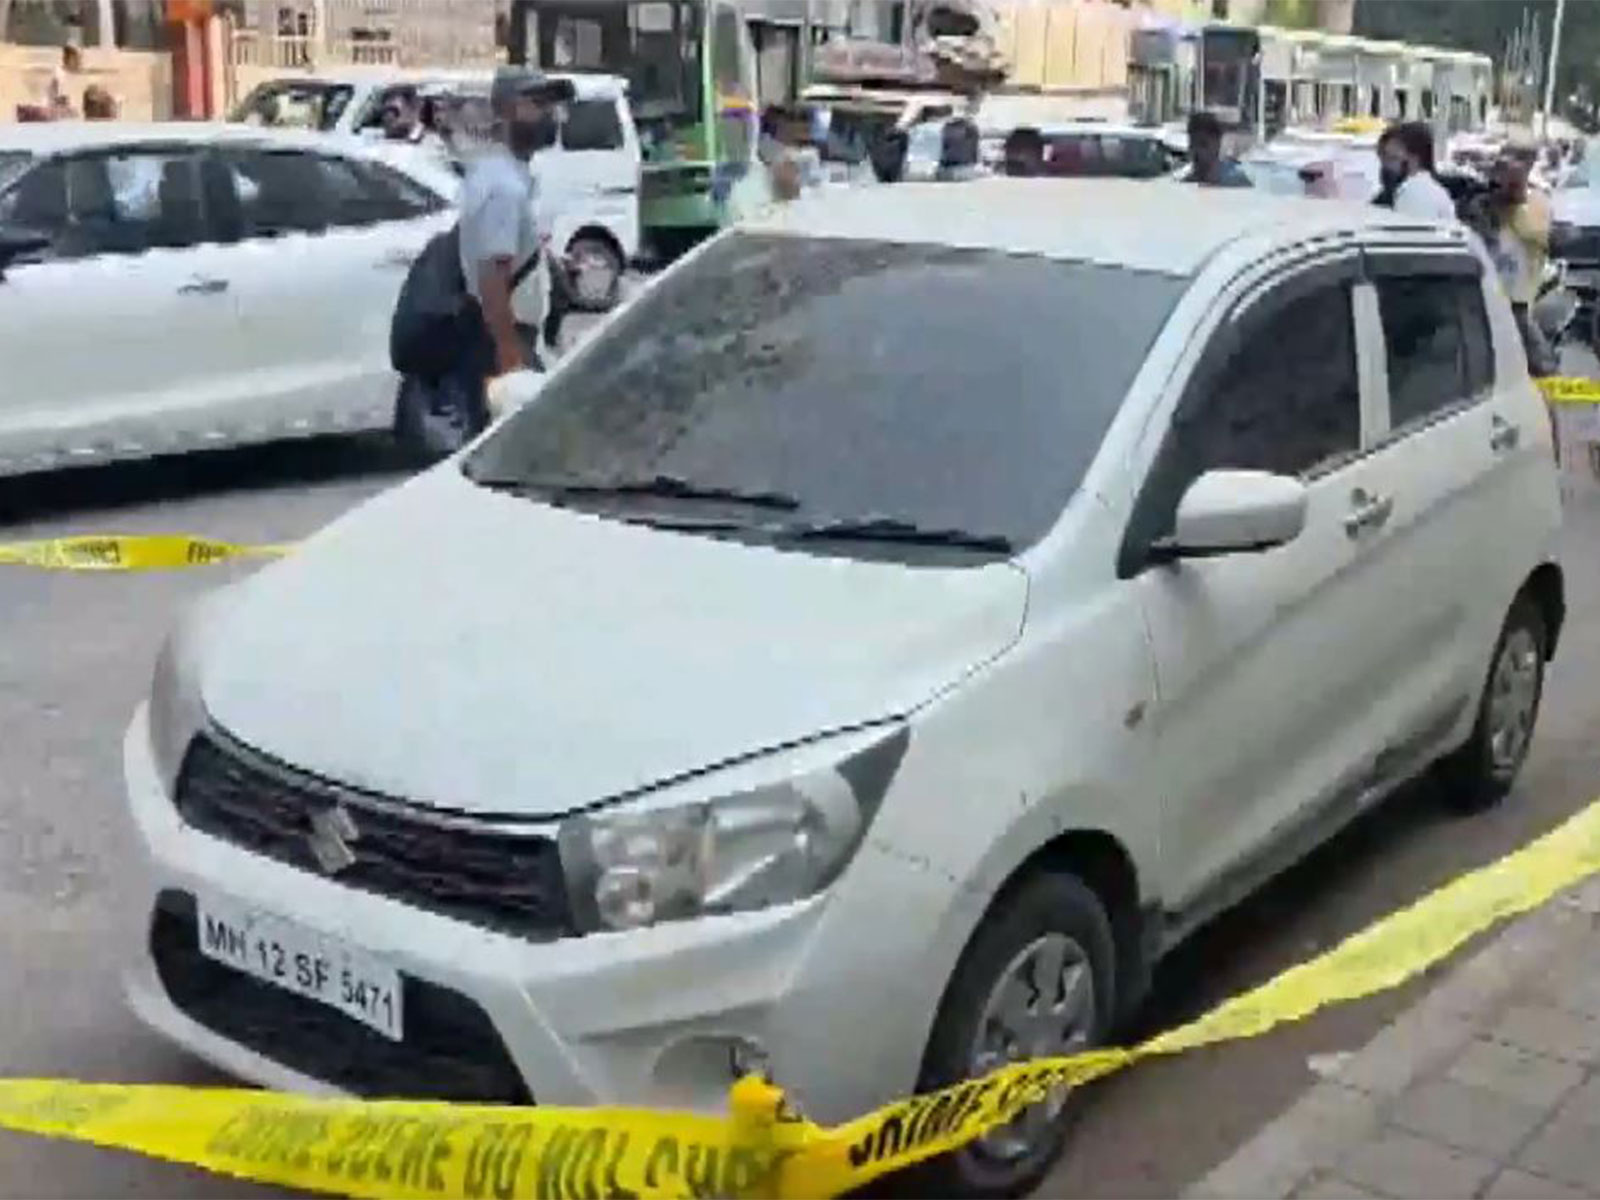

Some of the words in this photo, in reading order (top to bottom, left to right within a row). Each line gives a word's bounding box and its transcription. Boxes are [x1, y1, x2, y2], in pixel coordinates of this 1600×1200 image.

[205, 914, 247, 960] MH
[256, 939, 286, 977] 12
[294, 953, 329, 991] SF
[341, 969, 394, 1030] 5471
